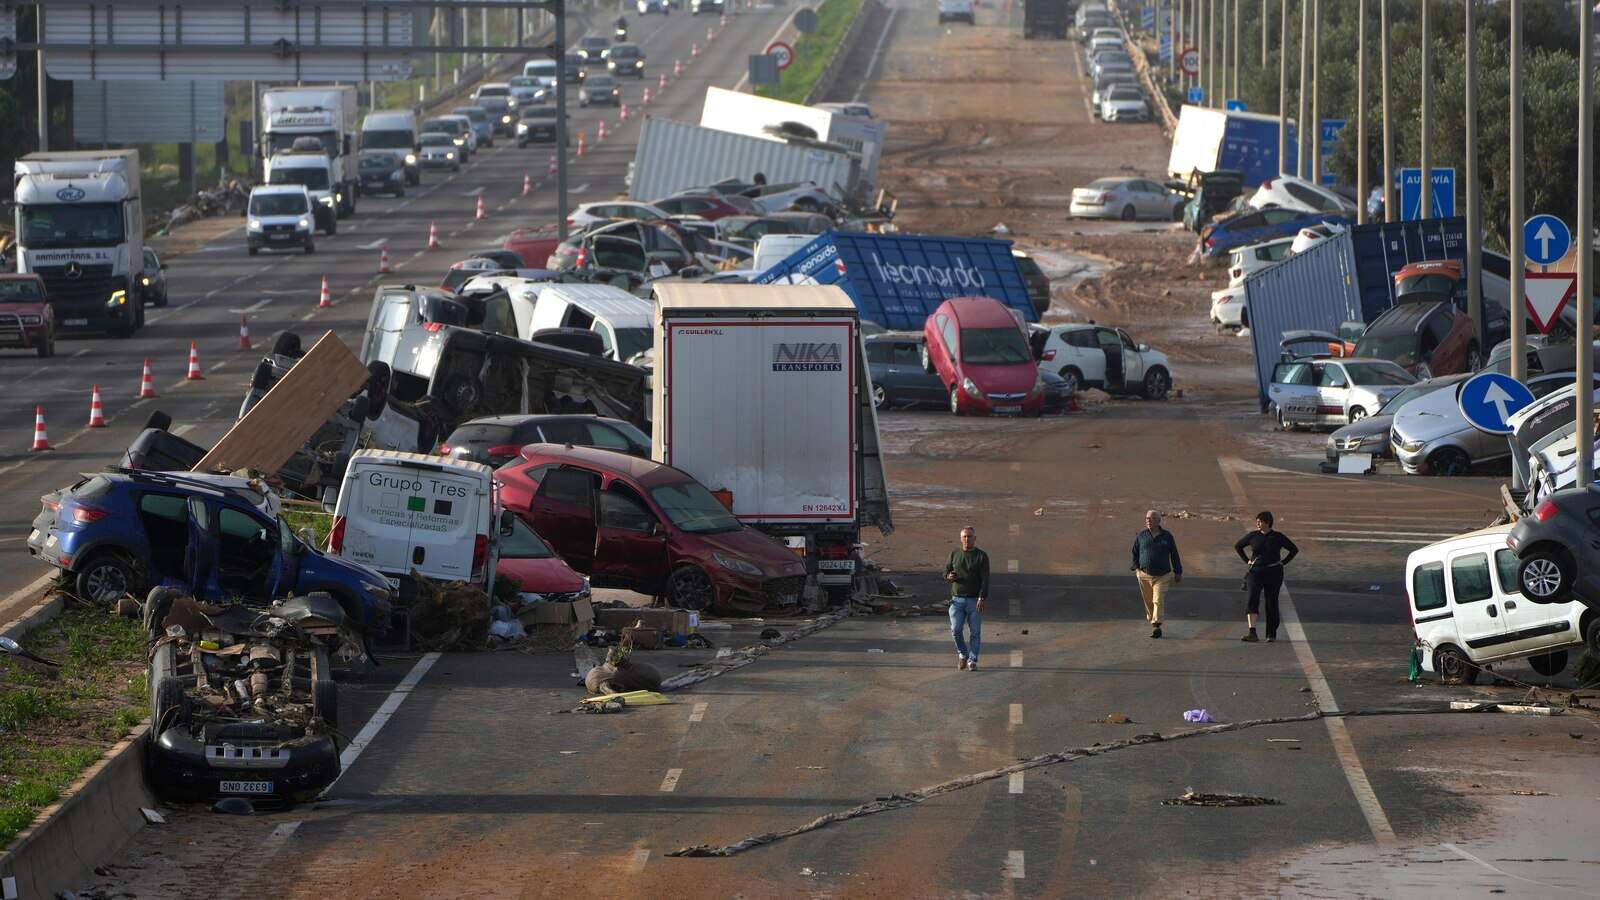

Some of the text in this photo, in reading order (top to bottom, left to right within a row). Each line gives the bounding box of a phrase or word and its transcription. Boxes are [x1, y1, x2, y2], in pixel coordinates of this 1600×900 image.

[1407, 173, 1450, 184] AUVÍA
[872, 252, 985, 288] leonardo
[775, 343, 841, 362] NIKA
[775, 363, 840, 371] TRANSPORTS
[369, 472, 466, 498] Grupo Tres
[416, 512, 460, 526] Reformas
